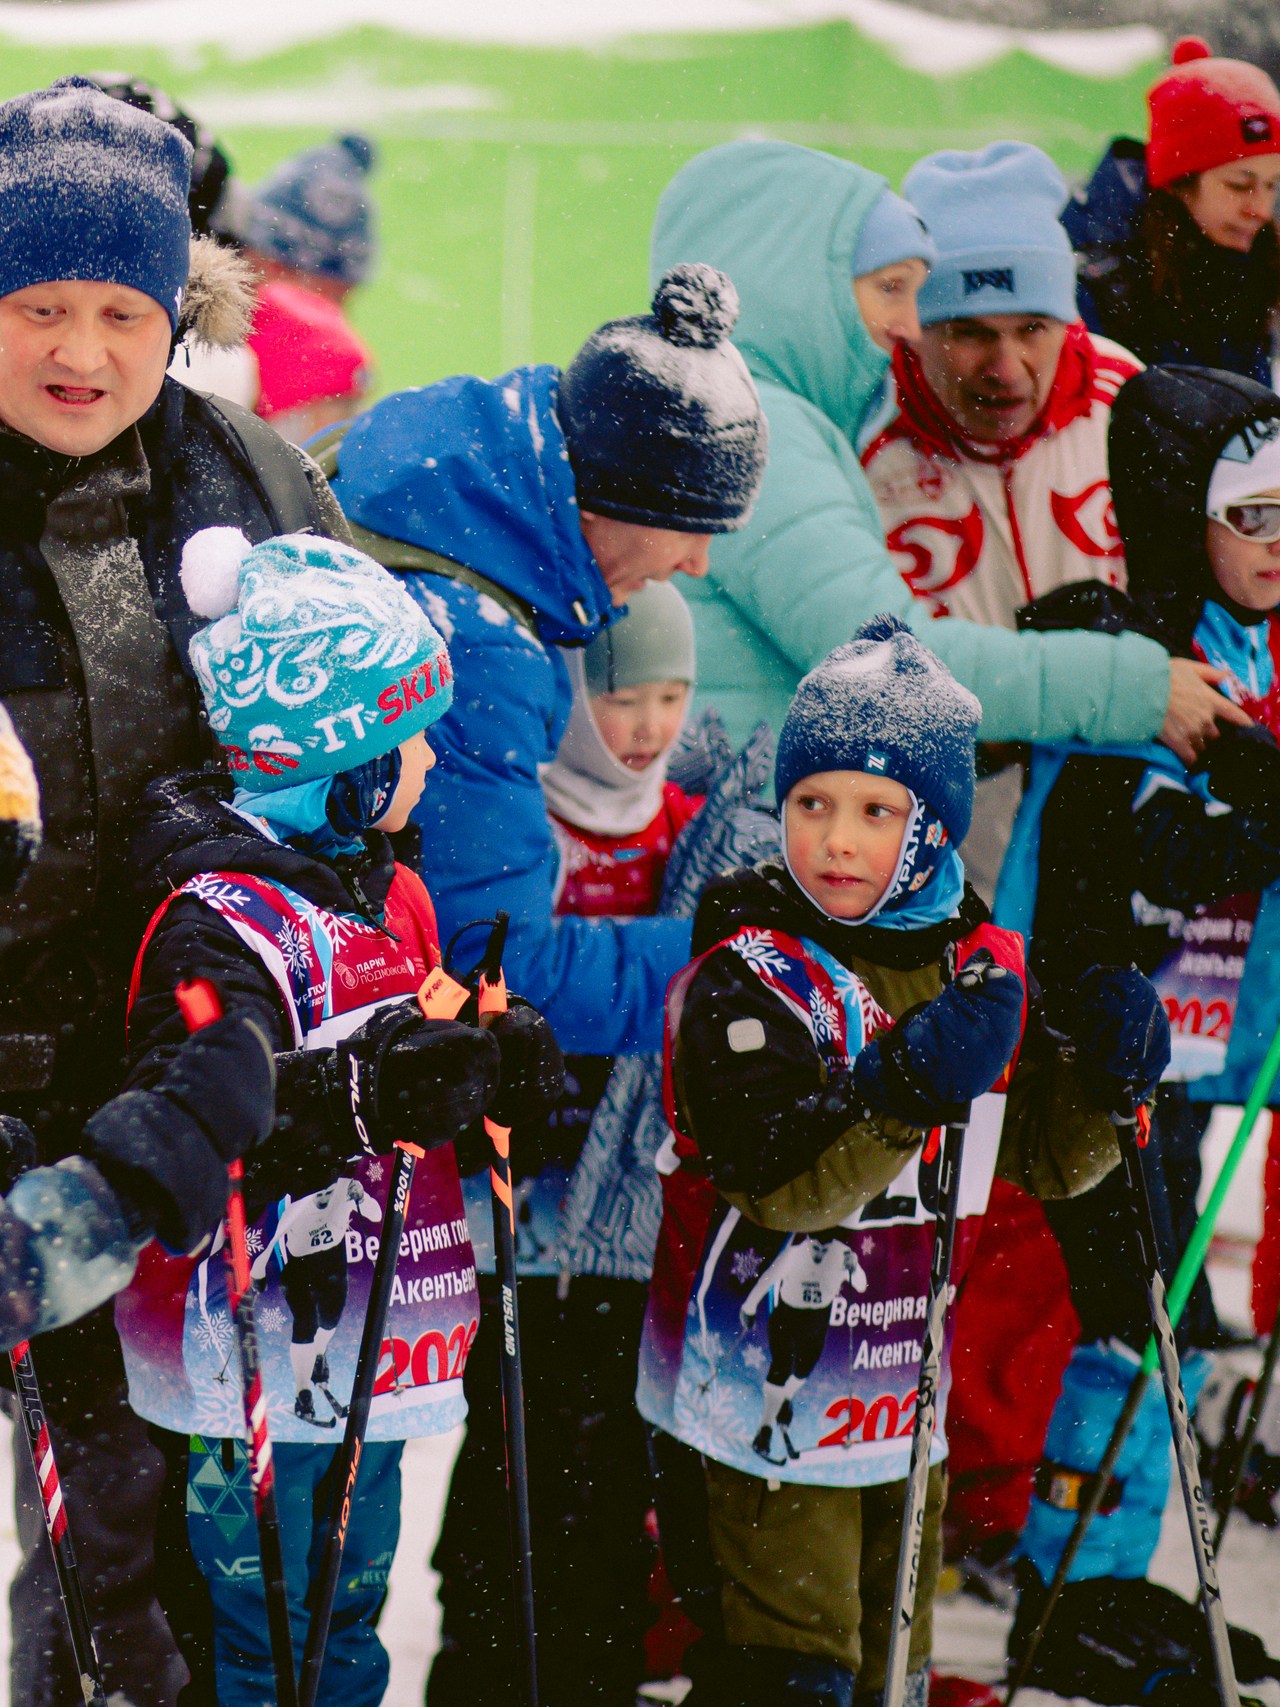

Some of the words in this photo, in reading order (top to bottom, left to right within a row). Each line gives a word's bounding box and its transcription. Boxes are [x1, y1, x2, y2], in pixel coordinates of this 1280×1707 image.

[345, 1222, 449, 1264] Веерняя
[502, 1284, 516, 1357] RUSLAND
[829, 1295, 928, 1332] Вечерняя
